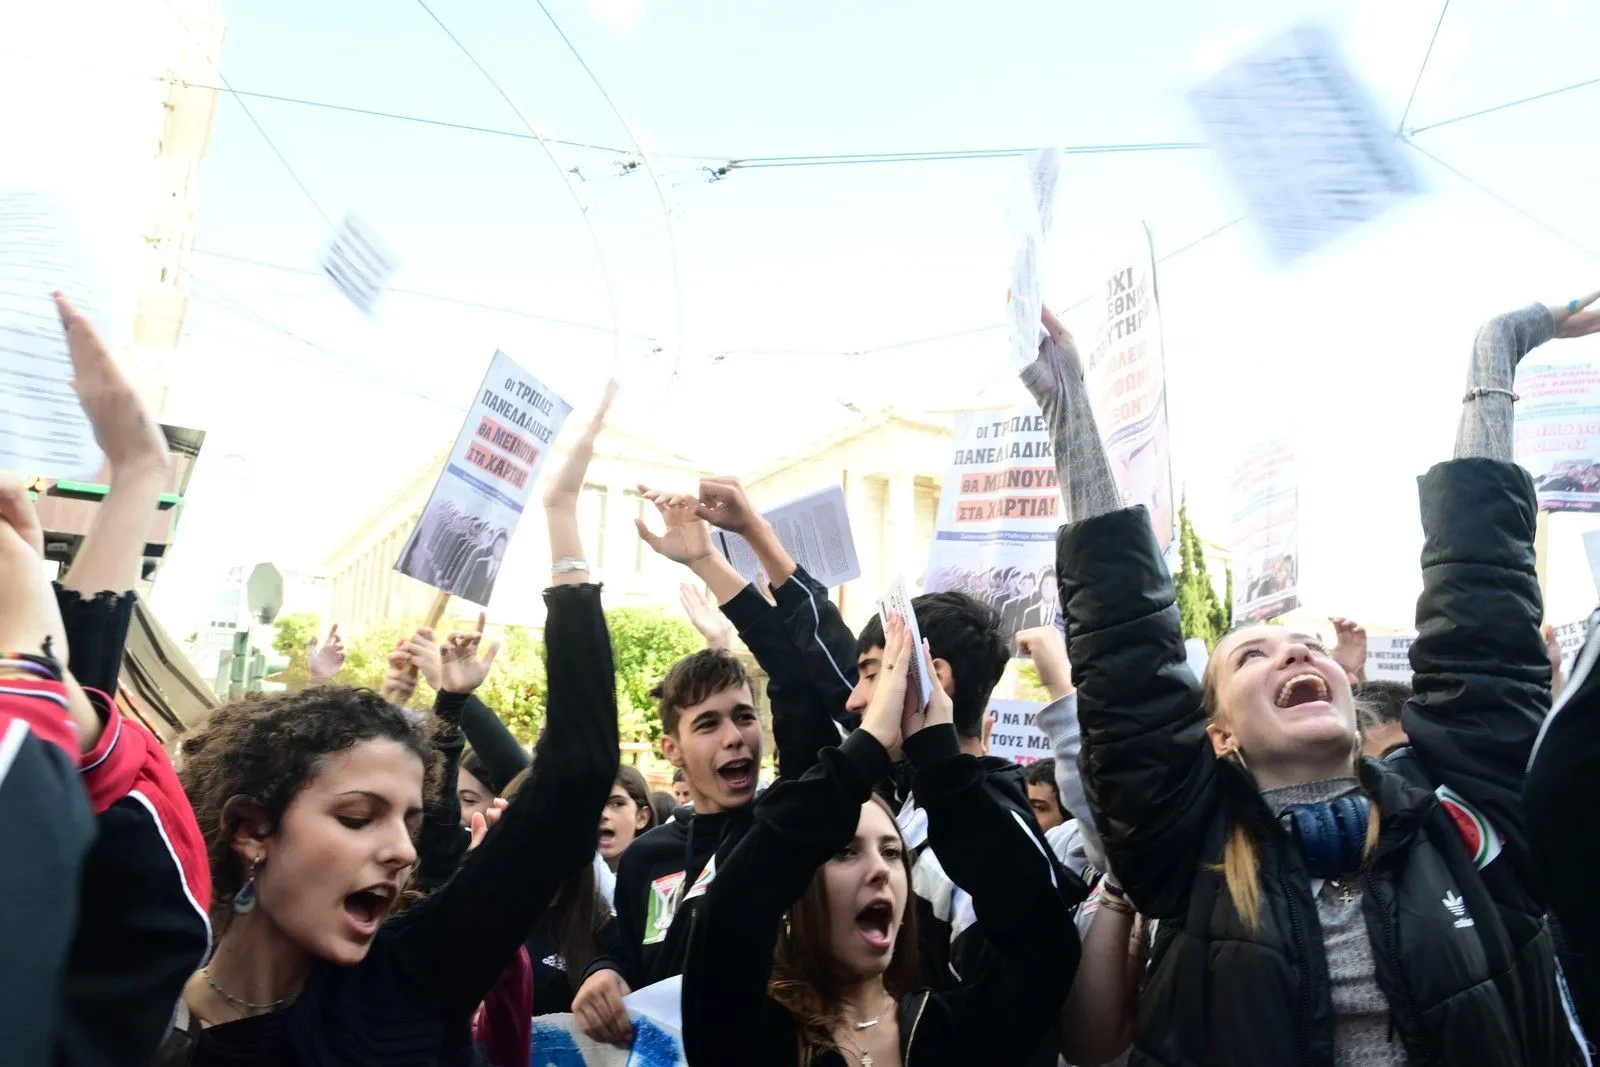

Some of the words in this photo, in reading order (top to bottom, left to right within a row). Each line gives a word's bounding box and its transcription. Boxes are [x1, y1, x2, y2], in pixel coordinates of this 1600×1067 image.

[504, 378, 516, 392] ΟΙ
[515, 381, 554, 417] ΤΡΙΠΛΕΣ
[481, 389, 553, 444] ΠΑΝΕΛΛΑΔΙΚΕΣ
[976, 426, 989, 439] ΟΙ
[992, 415, 1048, 438] ΤΡΙΠΛΕ
[478, 423, 493, 441] ΘΑ
[491, 427, 537, 465] ΜΕΙΝΟΥΝ
[953, 441, 1053, 465] ΠΑΝΕΛΛΑΔΙΚ
[467, 447, 487, 466] ΣΤΑ
[485, 454, 527, 488] ΧΑΡΤΙΑ!
[961, 479, 979, 493] ΘΑ
[958, 506, 983, 521] ΣΤΑ
[987, 498, 1056, 520] ΧΑΡΤΙΑ!
[1003, 712, 1019, 725] ΝΑ
[1024, 713, 1036, 726] Μ
[992, 733, 1024, 748] ΤΟΥΣ
[1027, 735, 1050, 750] ΜΑ
